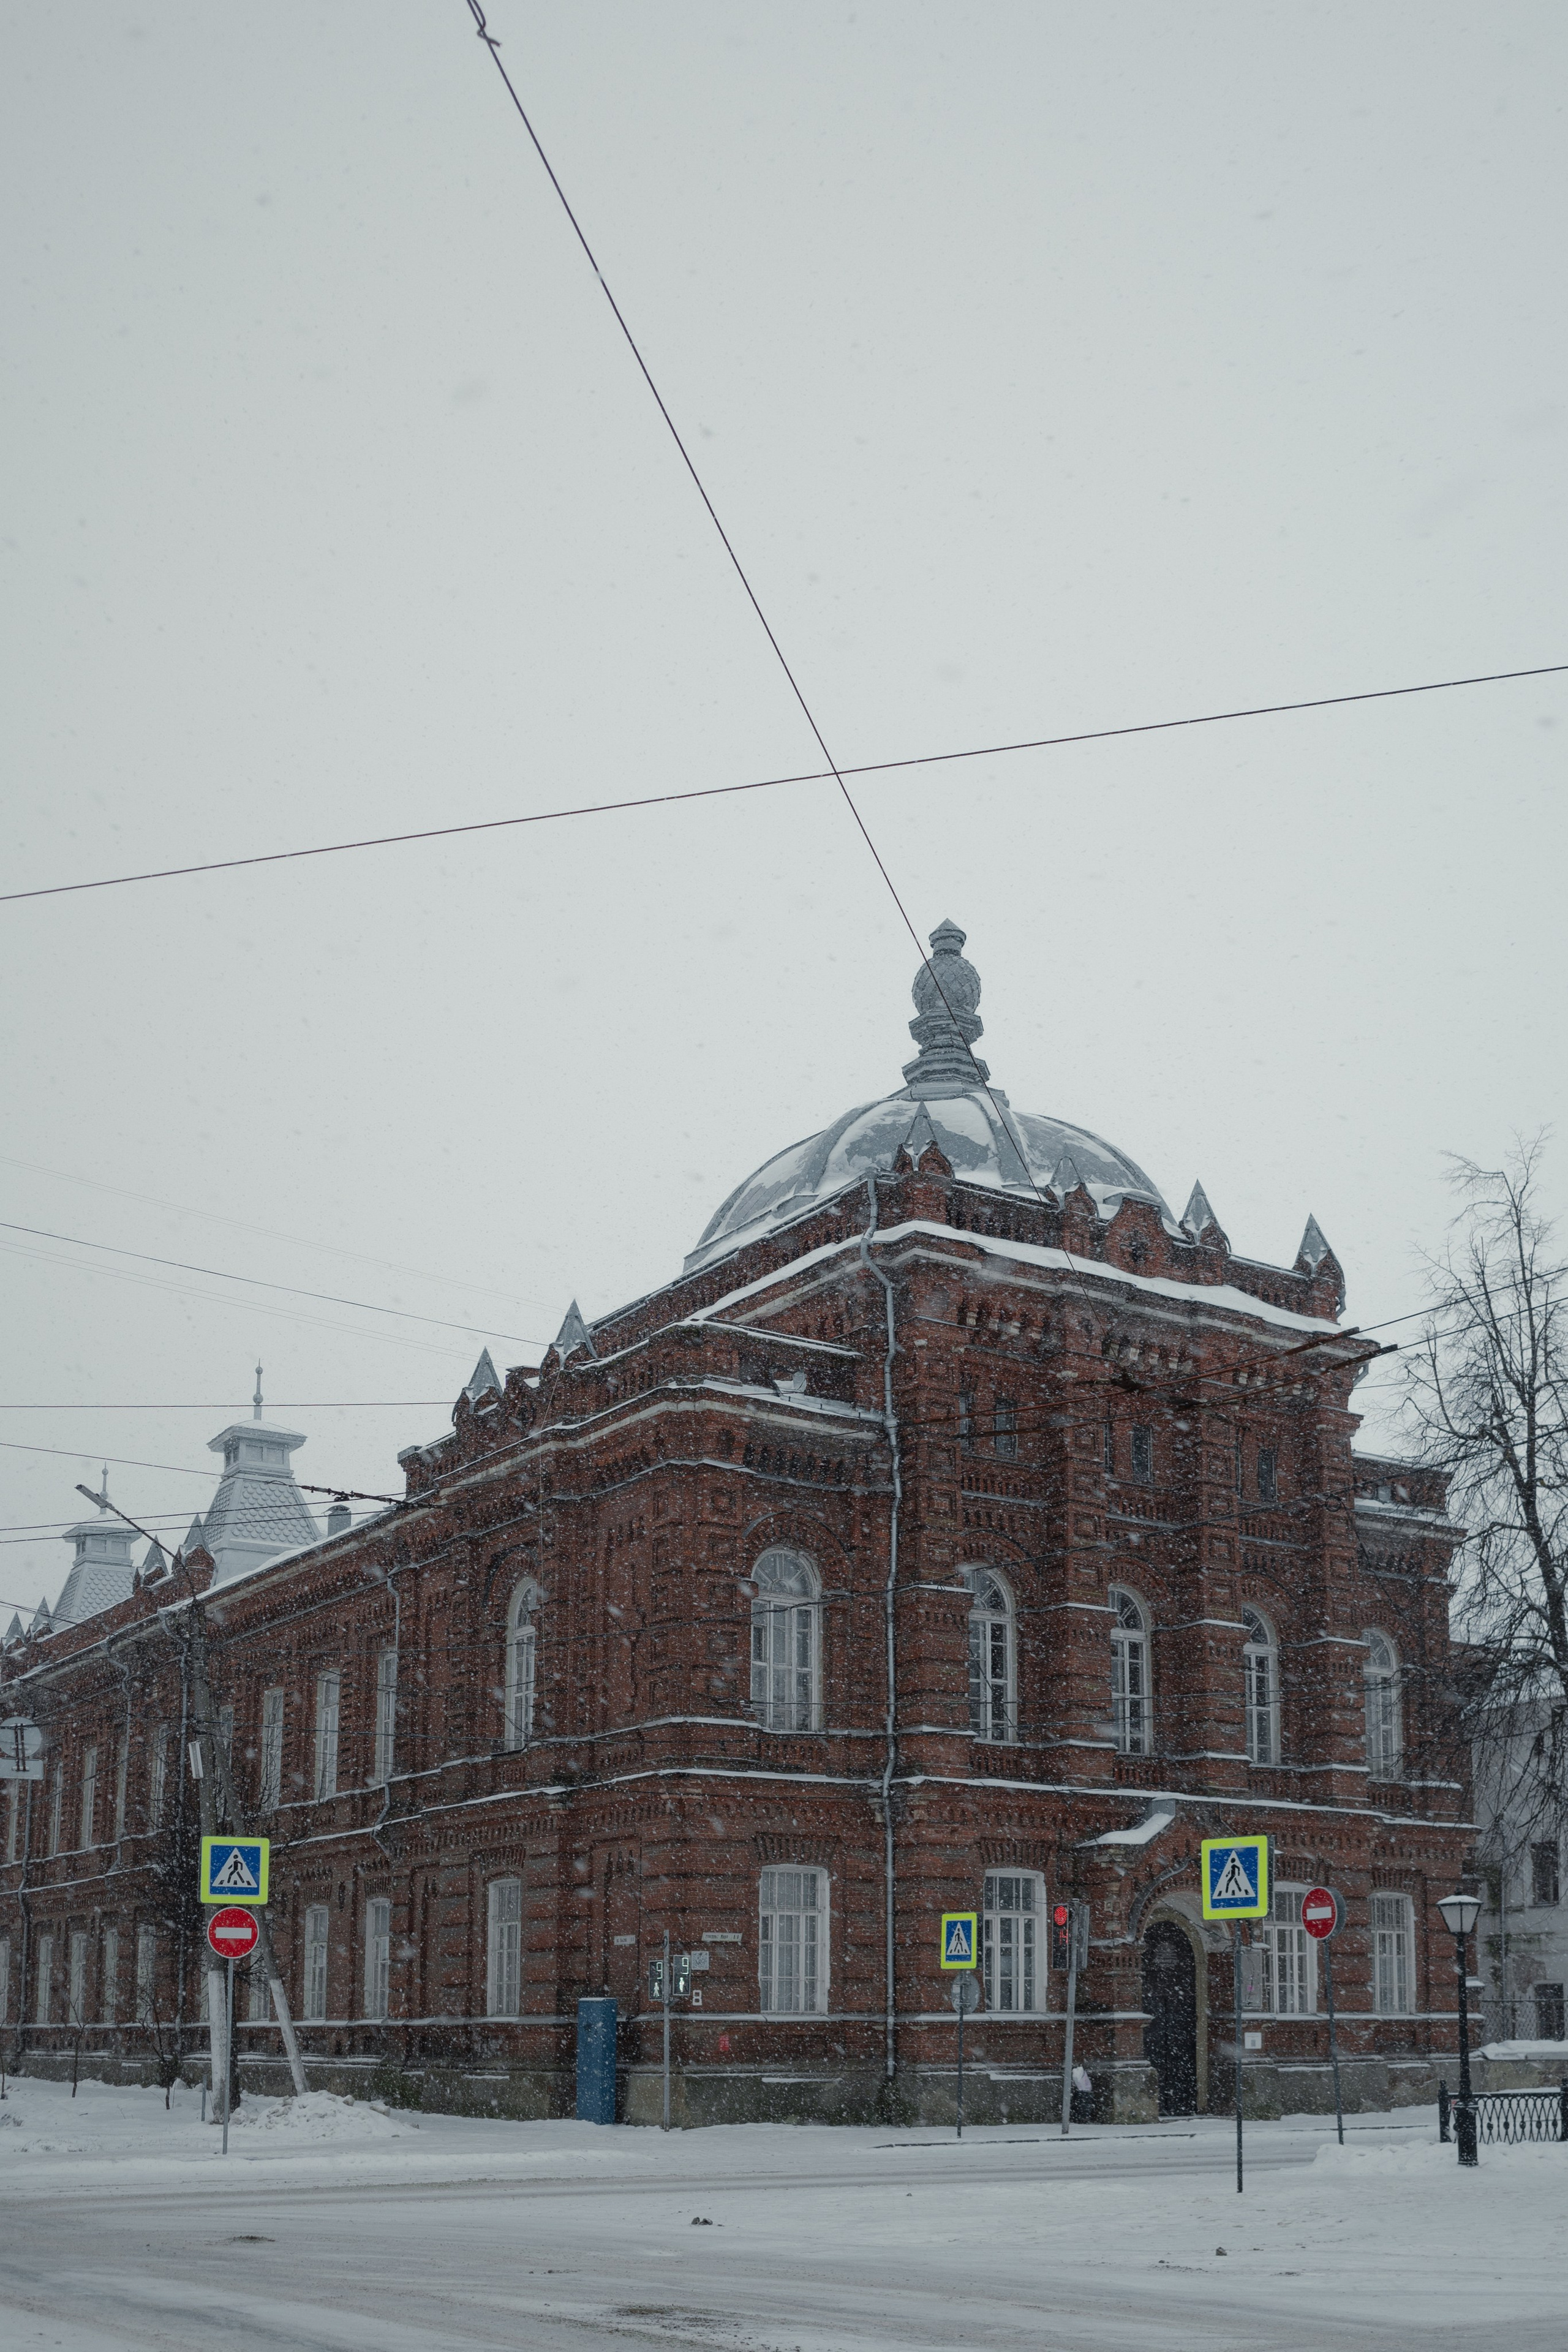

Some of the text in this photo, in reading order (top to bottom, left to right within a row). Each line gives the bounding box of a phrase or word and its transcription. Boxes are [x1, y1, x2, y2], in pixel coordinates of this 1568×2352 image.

[656, 1962, 663, 1980] 9
[682, 1957, 689, 1975] 9
[692, 1989, 703, 2006] 8
